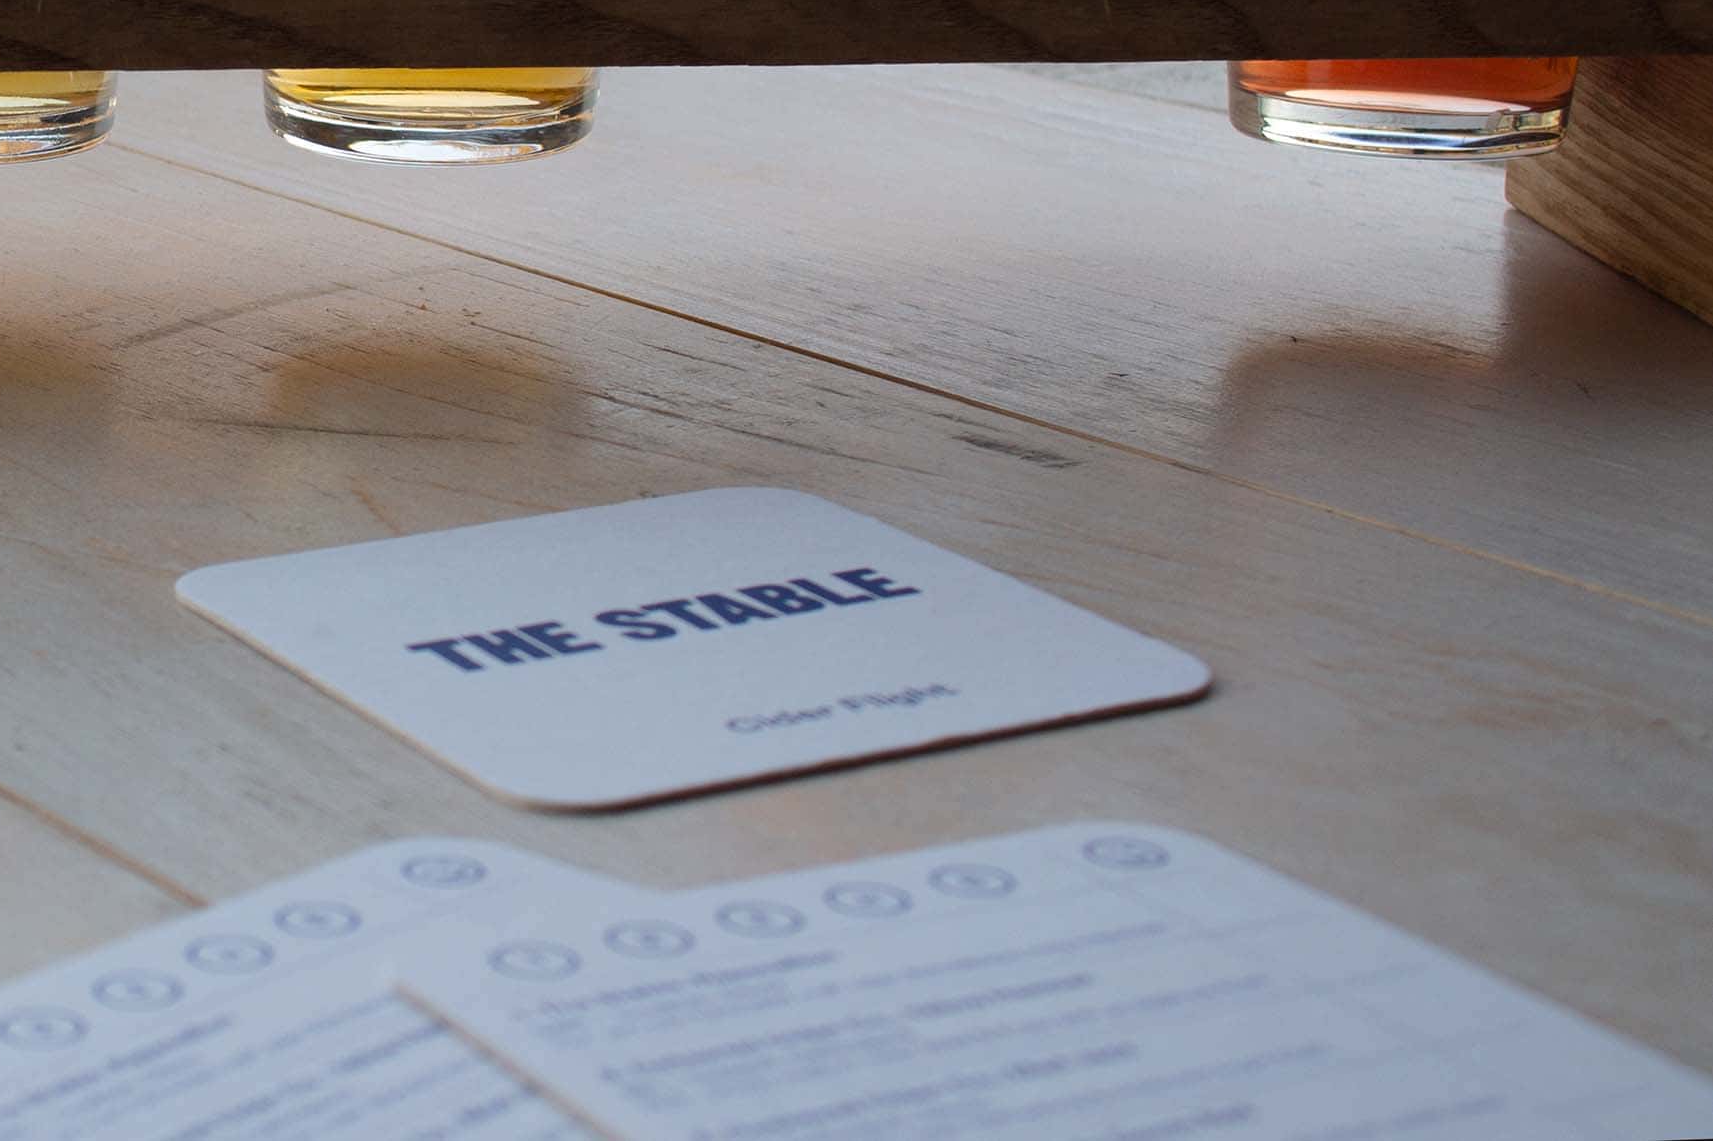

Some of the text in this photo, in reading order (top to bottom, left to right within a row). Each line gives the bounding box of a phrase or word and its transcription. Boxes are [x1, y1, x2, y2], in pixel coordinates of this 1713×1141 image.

[405, 567, 923, 672] THE STABLE
[724, 684, 962, 733] Cider Flight
